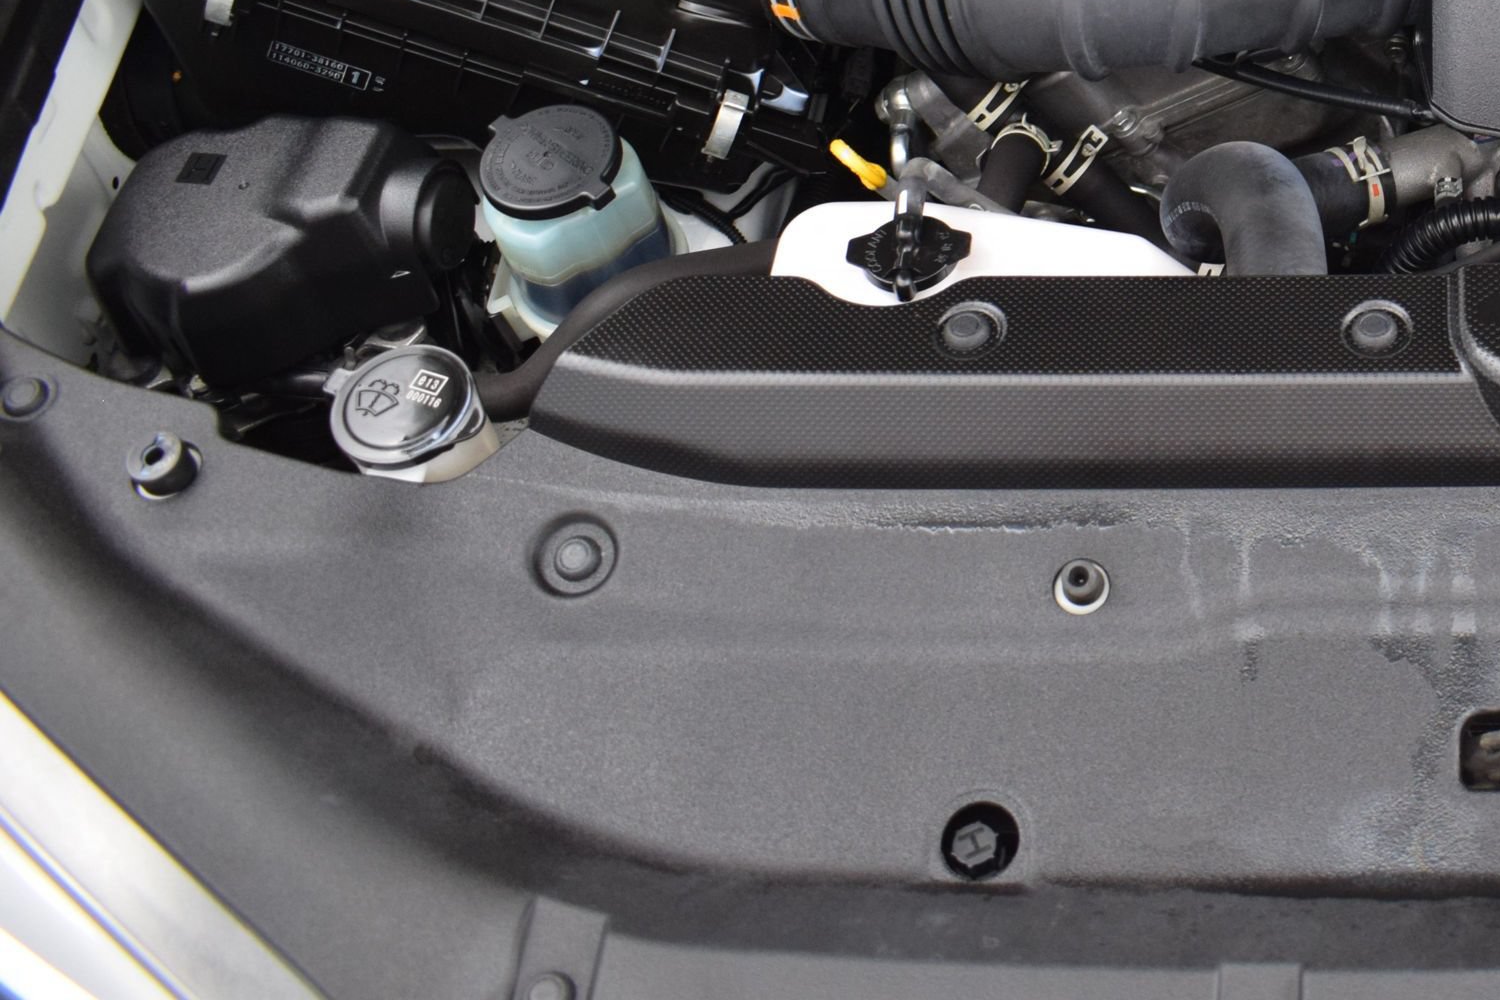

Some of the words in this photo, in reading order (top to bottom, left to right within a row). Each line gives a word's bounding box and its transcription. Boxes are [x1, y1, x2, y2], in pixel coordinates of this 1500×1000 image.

[351, 70, 361, 85] 1
[417, 375, 440, 390] e13
[405, 389, 443, 409] 000116
